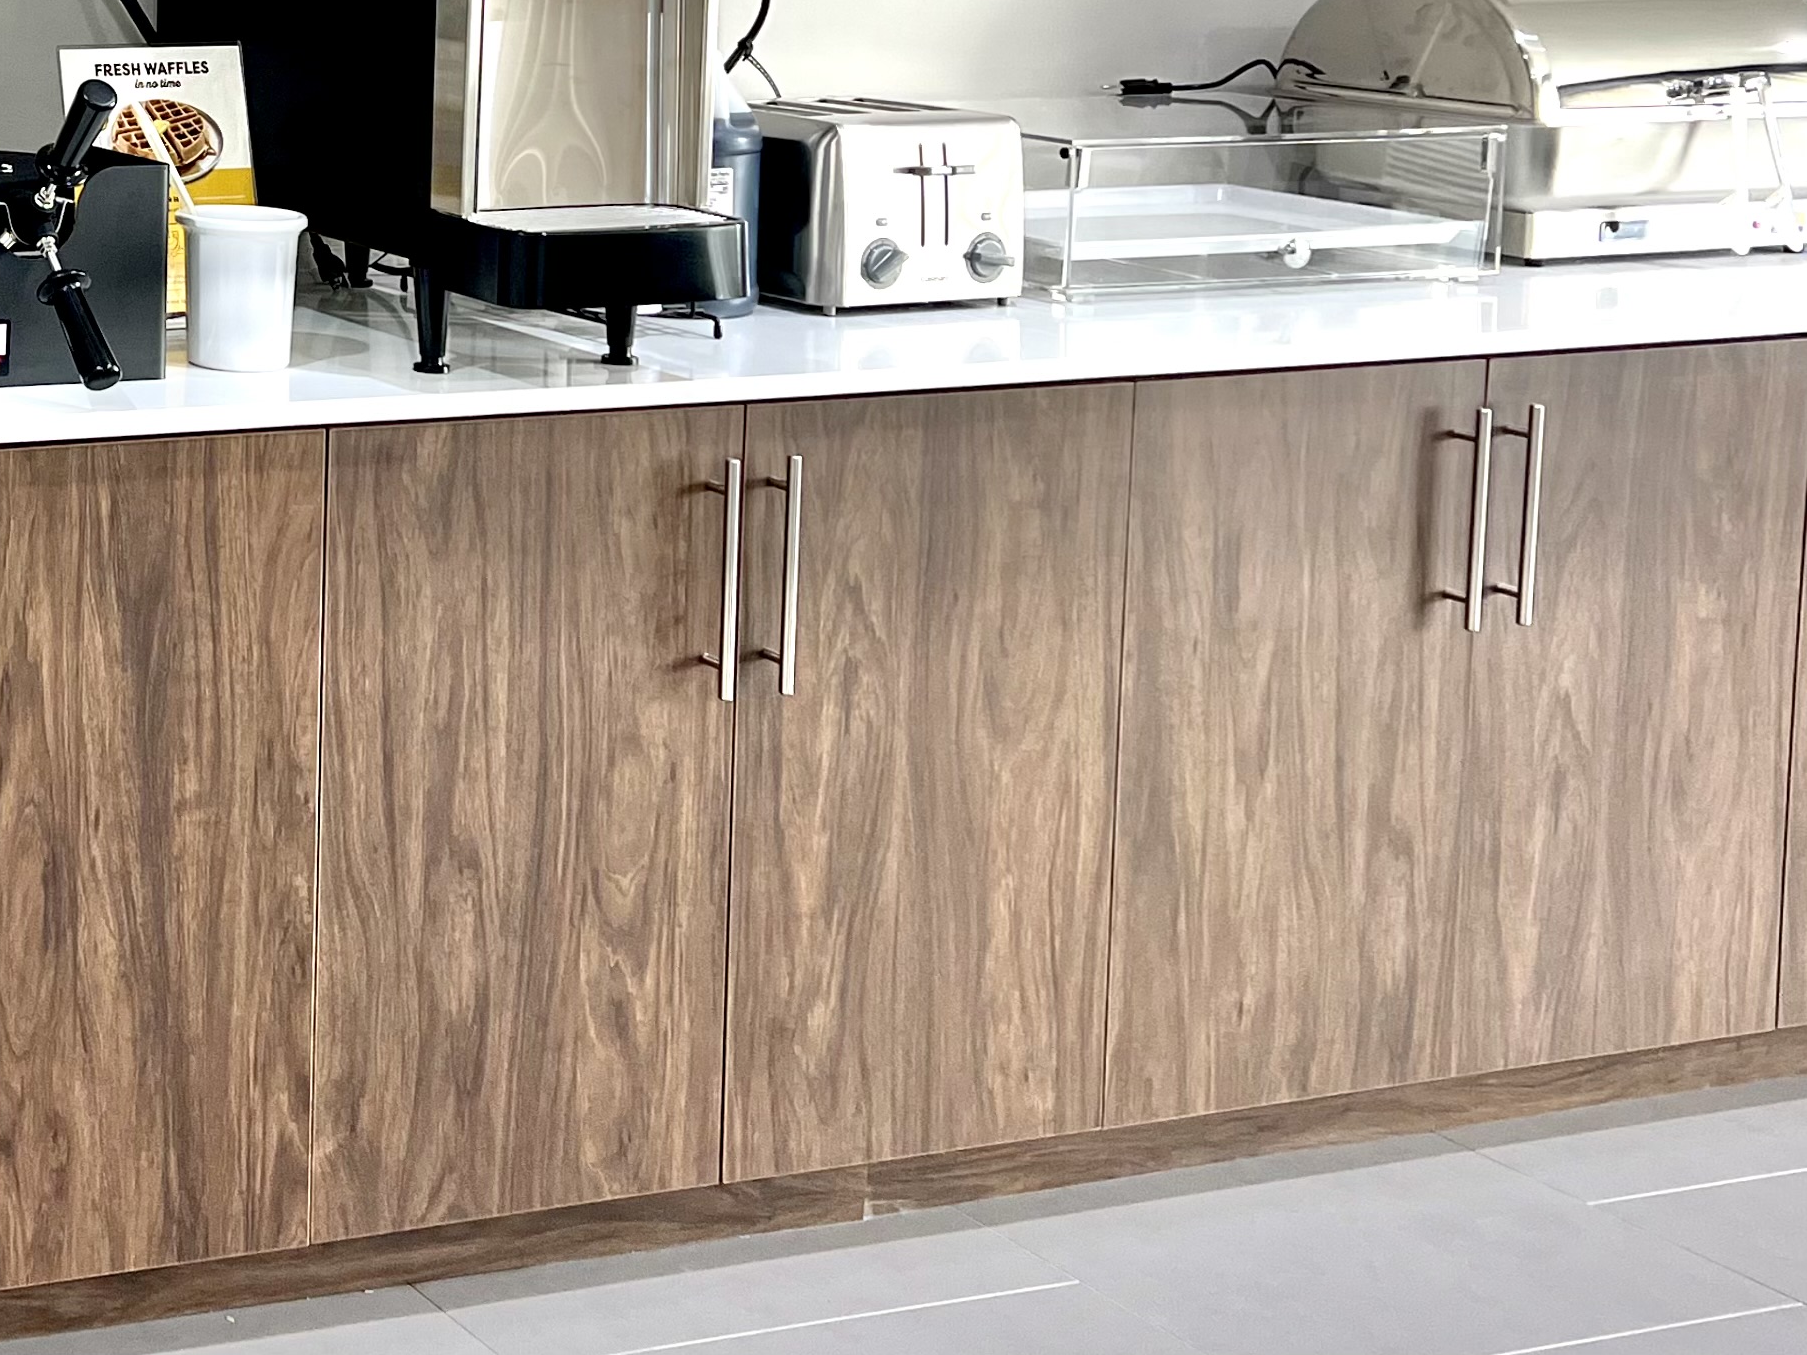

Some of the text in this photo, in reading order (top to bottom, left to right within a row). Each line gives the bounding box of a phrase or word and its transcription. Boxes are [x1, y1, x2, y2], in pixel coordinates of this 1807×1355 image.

[95, 61, 209, 76] FRESH WAFFLES
[135, 79, 144, 88] in
[160, 79, 181, 88] time
